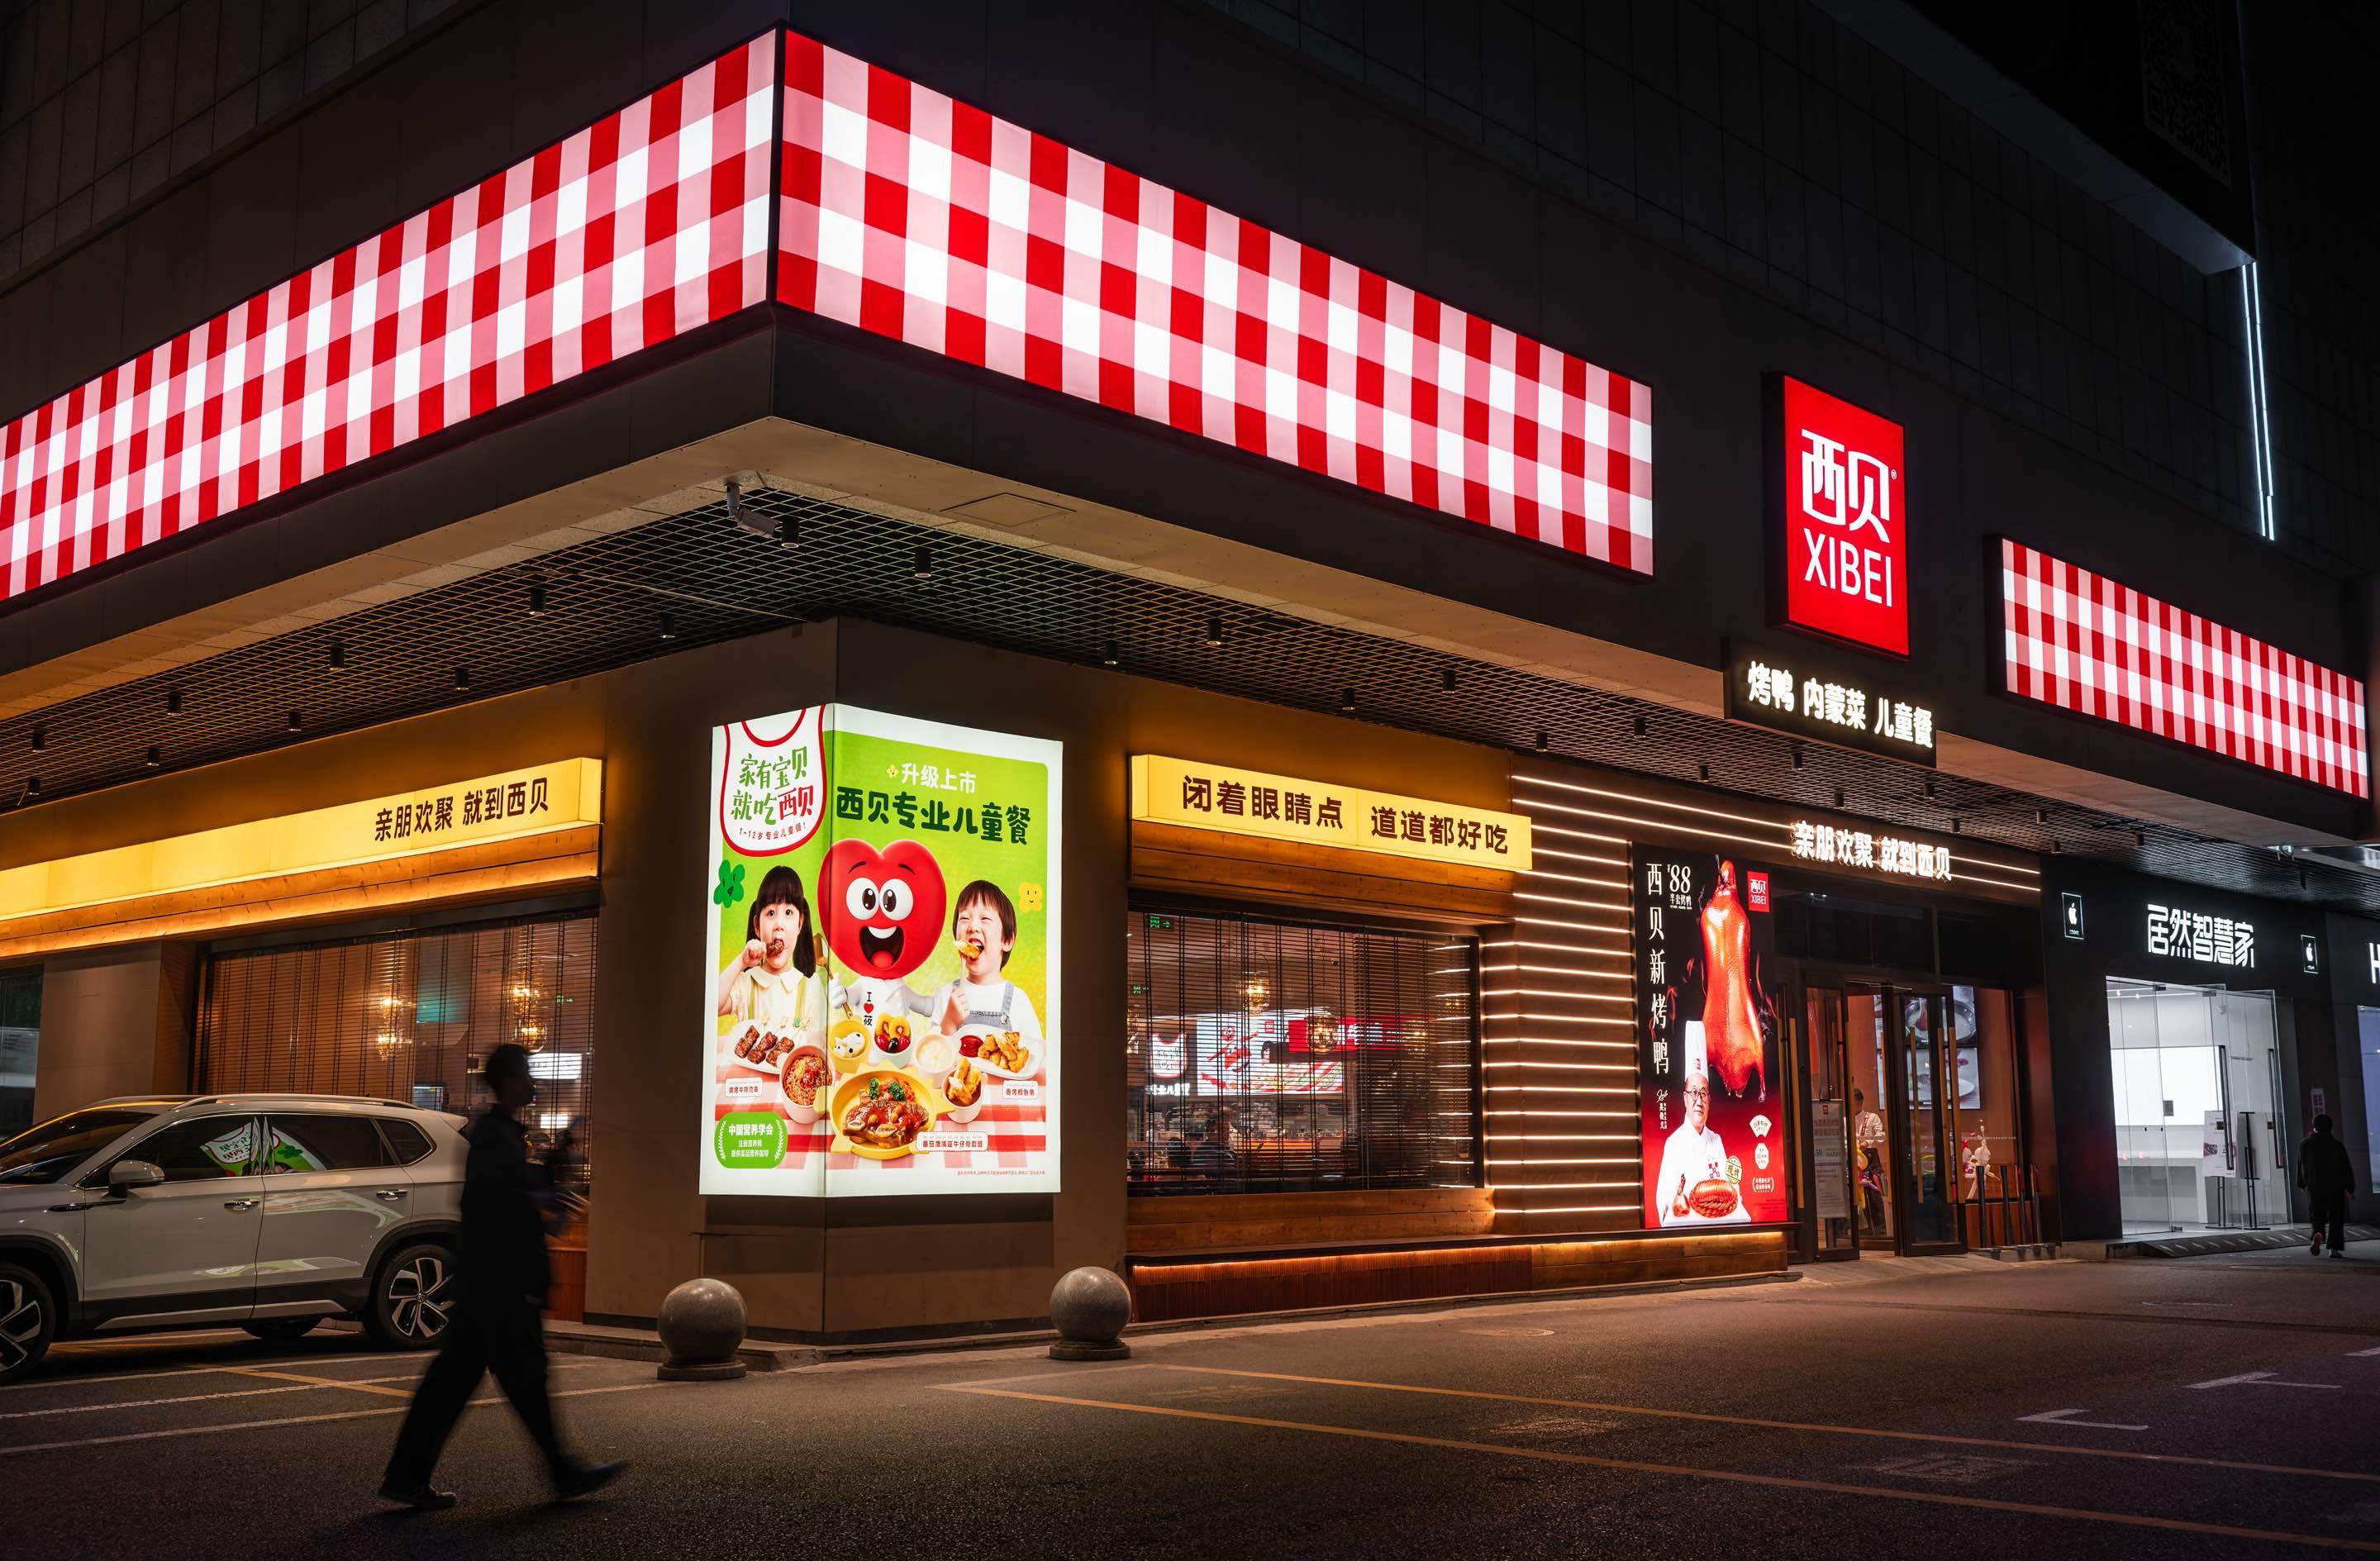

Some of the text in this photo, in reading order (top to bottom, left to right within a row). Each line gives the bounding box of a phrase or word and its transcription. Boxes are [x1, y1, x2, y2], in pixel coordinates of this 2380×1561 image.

[1801, 427, 1891, 544] 西贝
[1803, 526, 1893, 608] XIBEI
[1746, 660, 1934, 750] 烤鸭 内蒙菜 儿童餐
[737, 745, 809, 792] 家有宝贝
[901, 762, 978, 794] 升级上市
[374, 777, 549, 842] 亲朋欢聚 就到西贝
[731, 785, 815, 826] 就吃西贝
[835, 785, 1032, 846] 西贝专业儿童餐
[1182, 774, 1509, 854] 闭着眼睛点 道道都好吃
[1792, 820, 1953, 881] 亲朋欢聚 就到西贝
[1750, 893, 1767, 905] XIBEI
[2147, 903, 2255, 968] 居然智慧家
[1645, 863, 1669, 1075] 西贝新烤鸭
